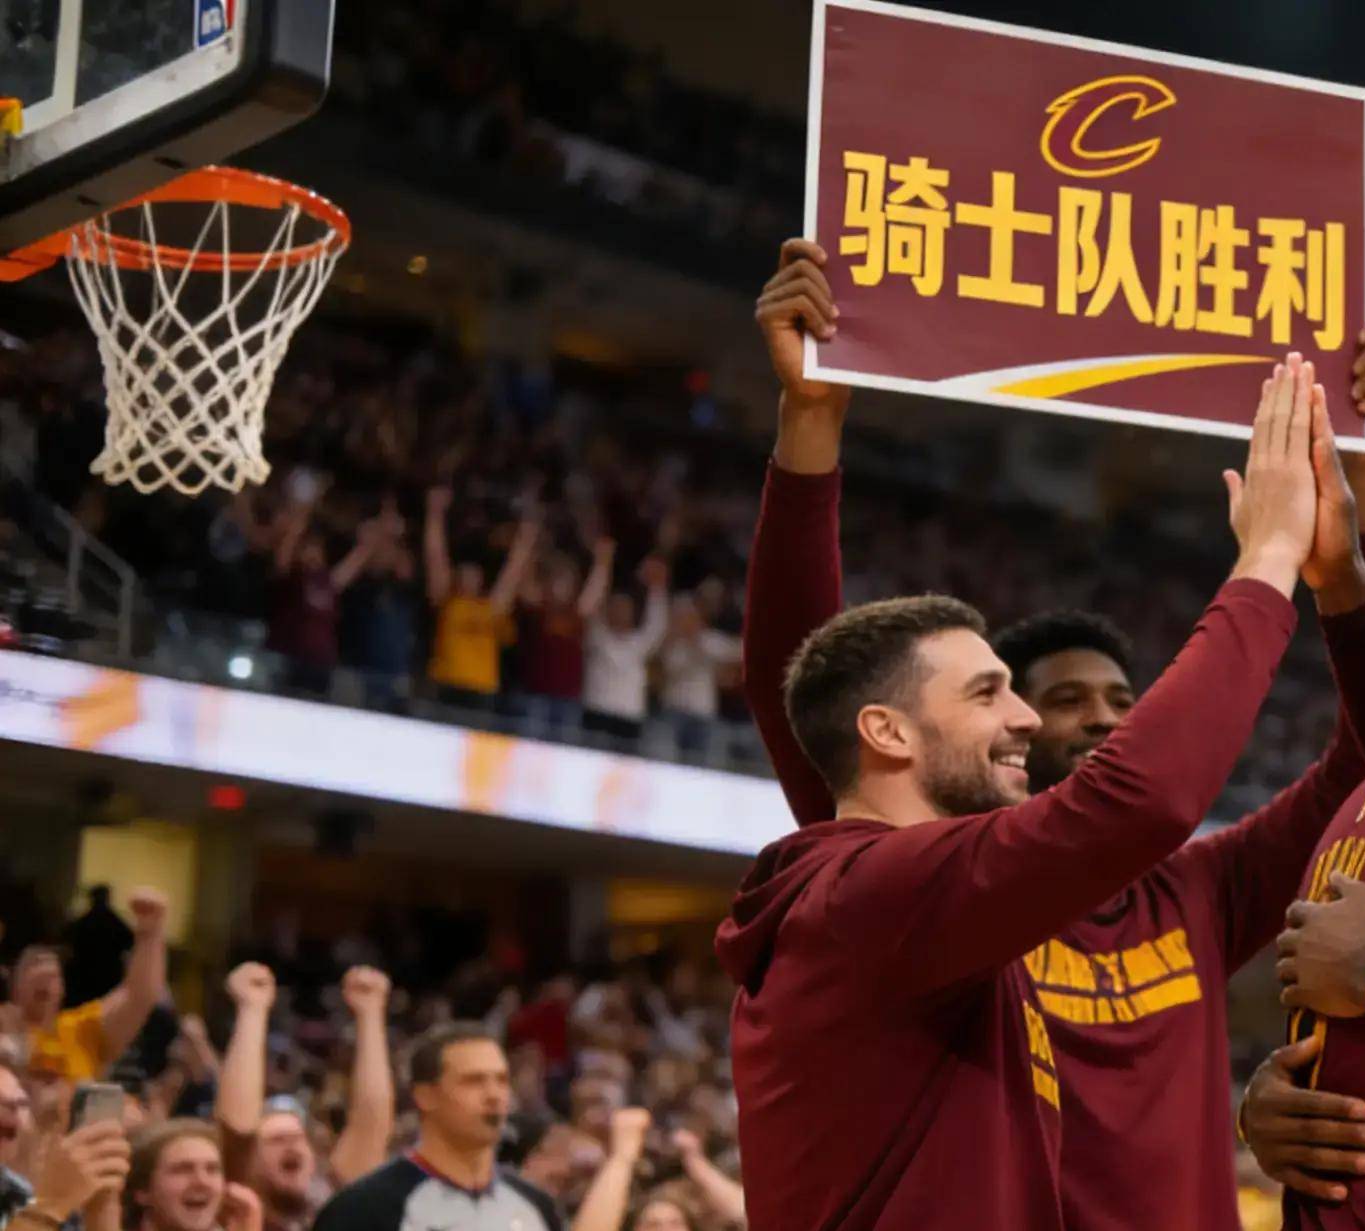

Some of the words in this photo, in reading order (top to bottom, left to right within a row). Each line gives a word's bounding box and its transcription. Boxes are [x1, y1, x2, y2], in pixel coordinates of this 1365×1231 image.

[1041, 75, 1176, 178] C
[839, 151, 1346, 351] 骑士队胜利
